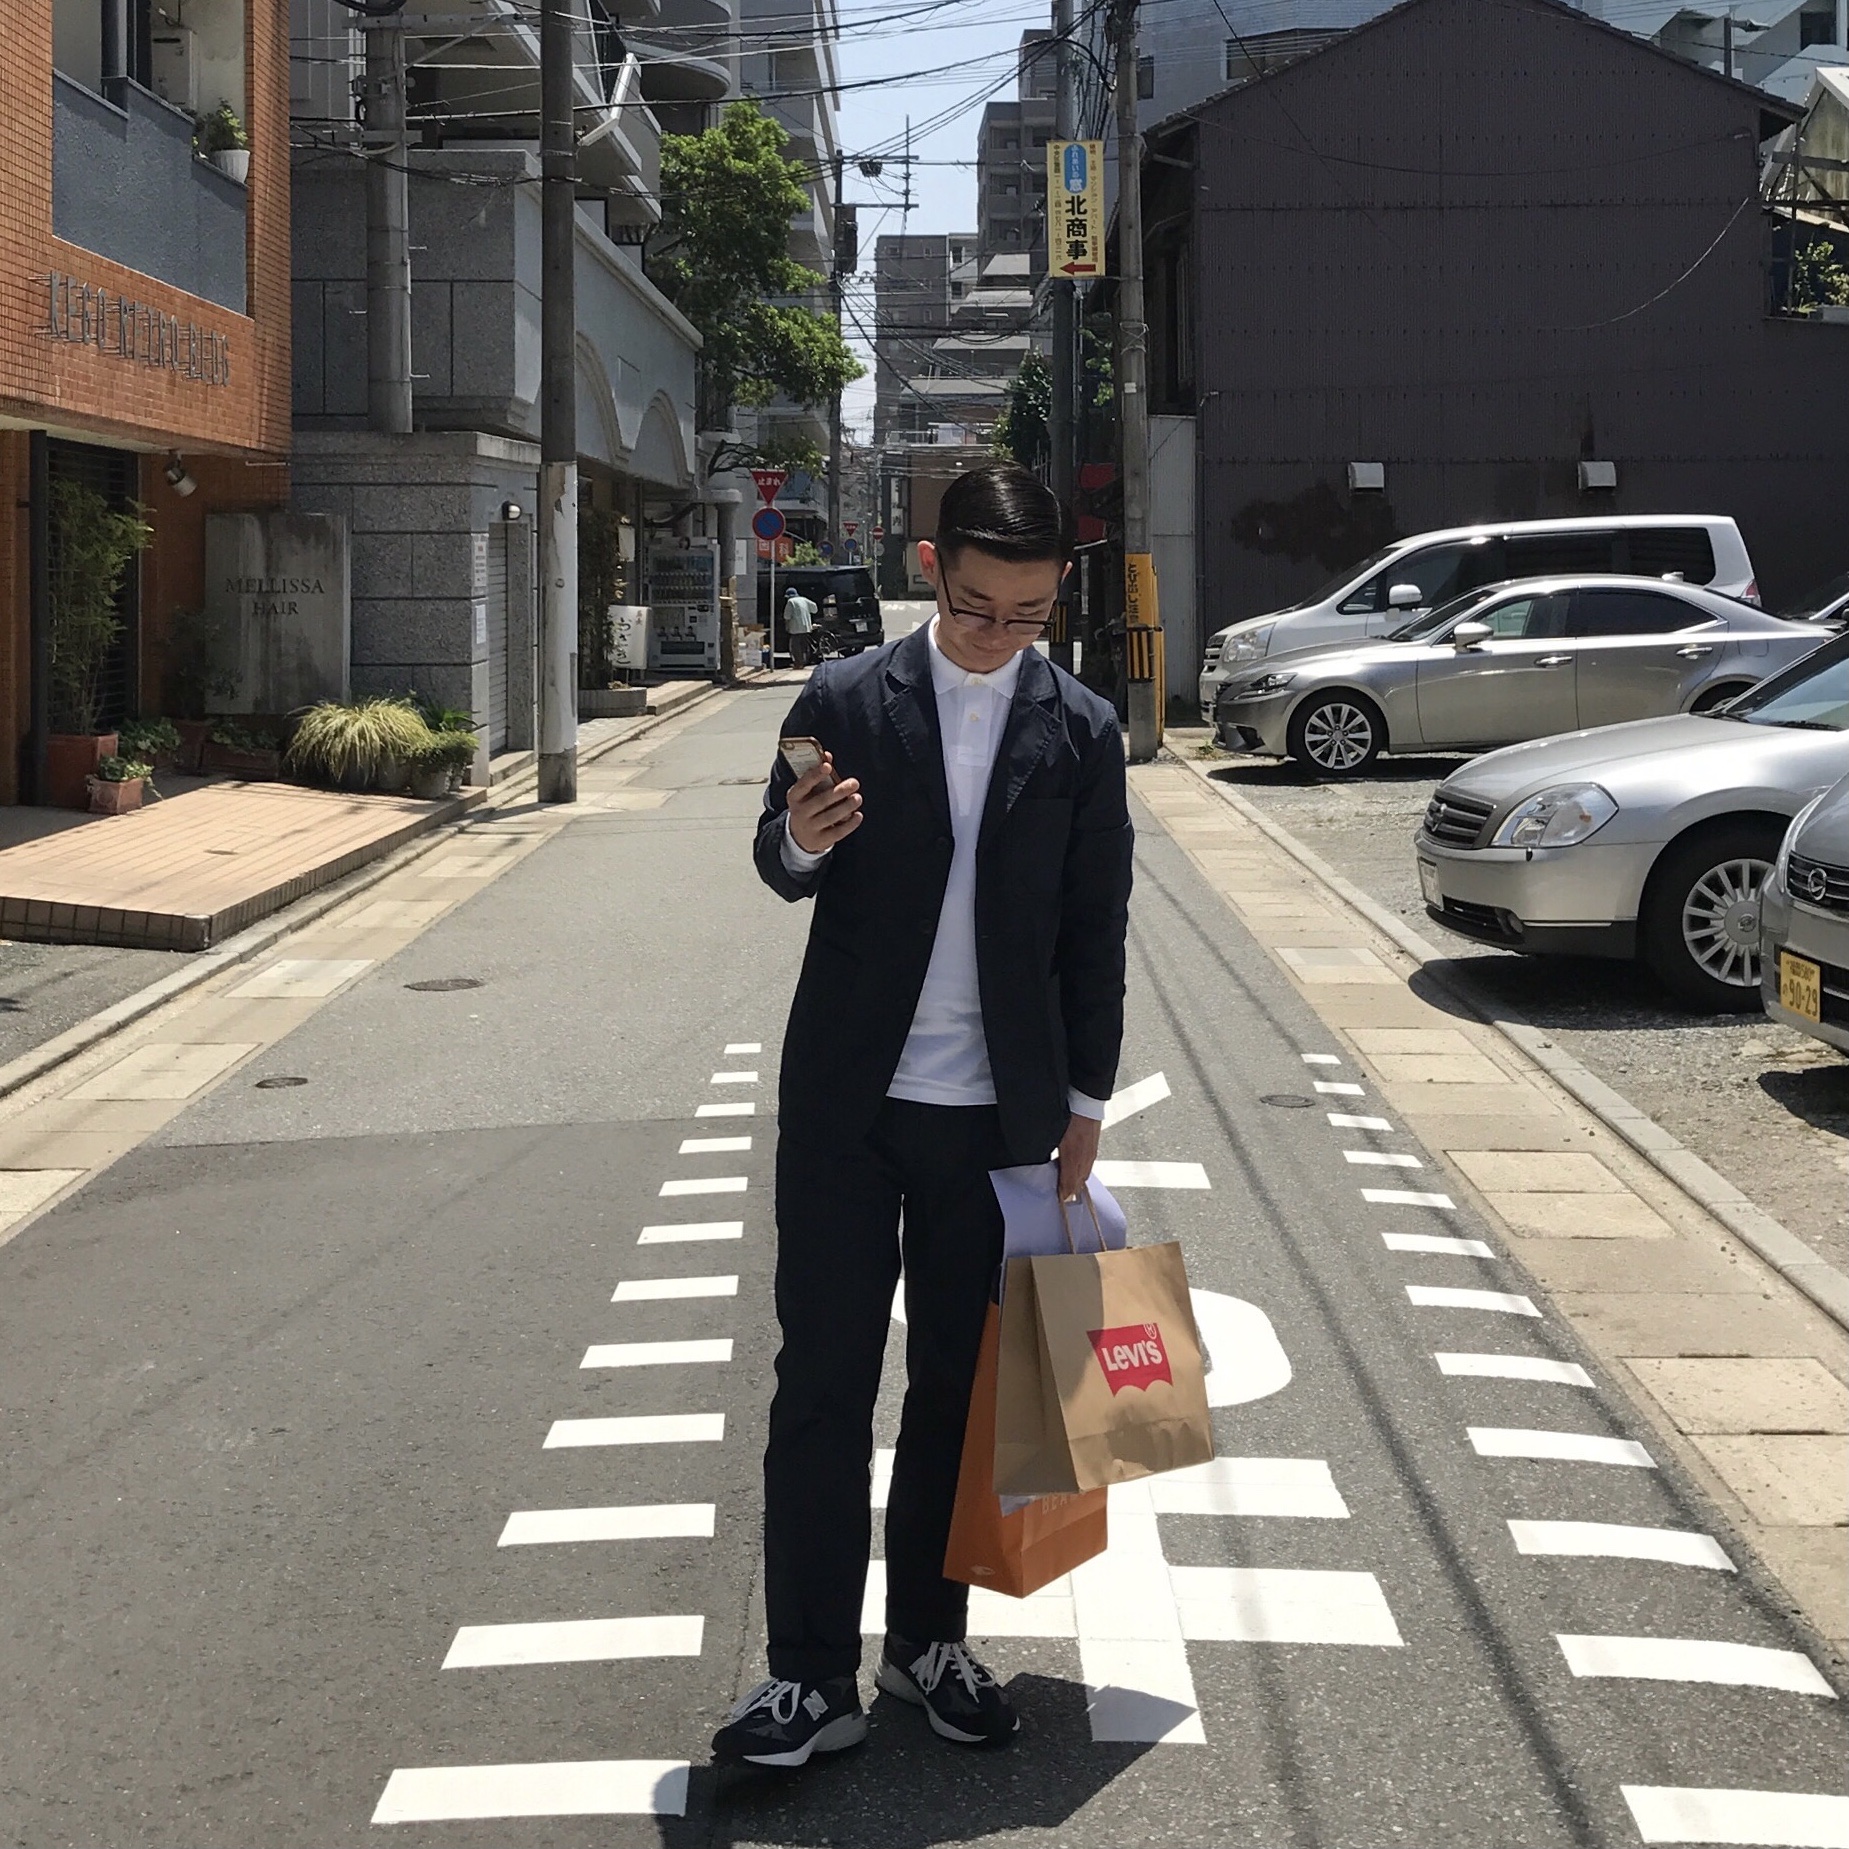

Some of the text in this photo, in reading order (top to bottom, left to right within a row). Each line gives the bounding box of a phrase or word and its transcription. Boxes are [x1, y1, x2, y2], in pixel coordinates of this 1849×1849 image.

[1065, 195, 1088, 260] 北商事
[757, 477, 781, 486] 止まれ
[225, 578, 325, 594] MELLISSA
[252, 601, 299, 615] HAIR
